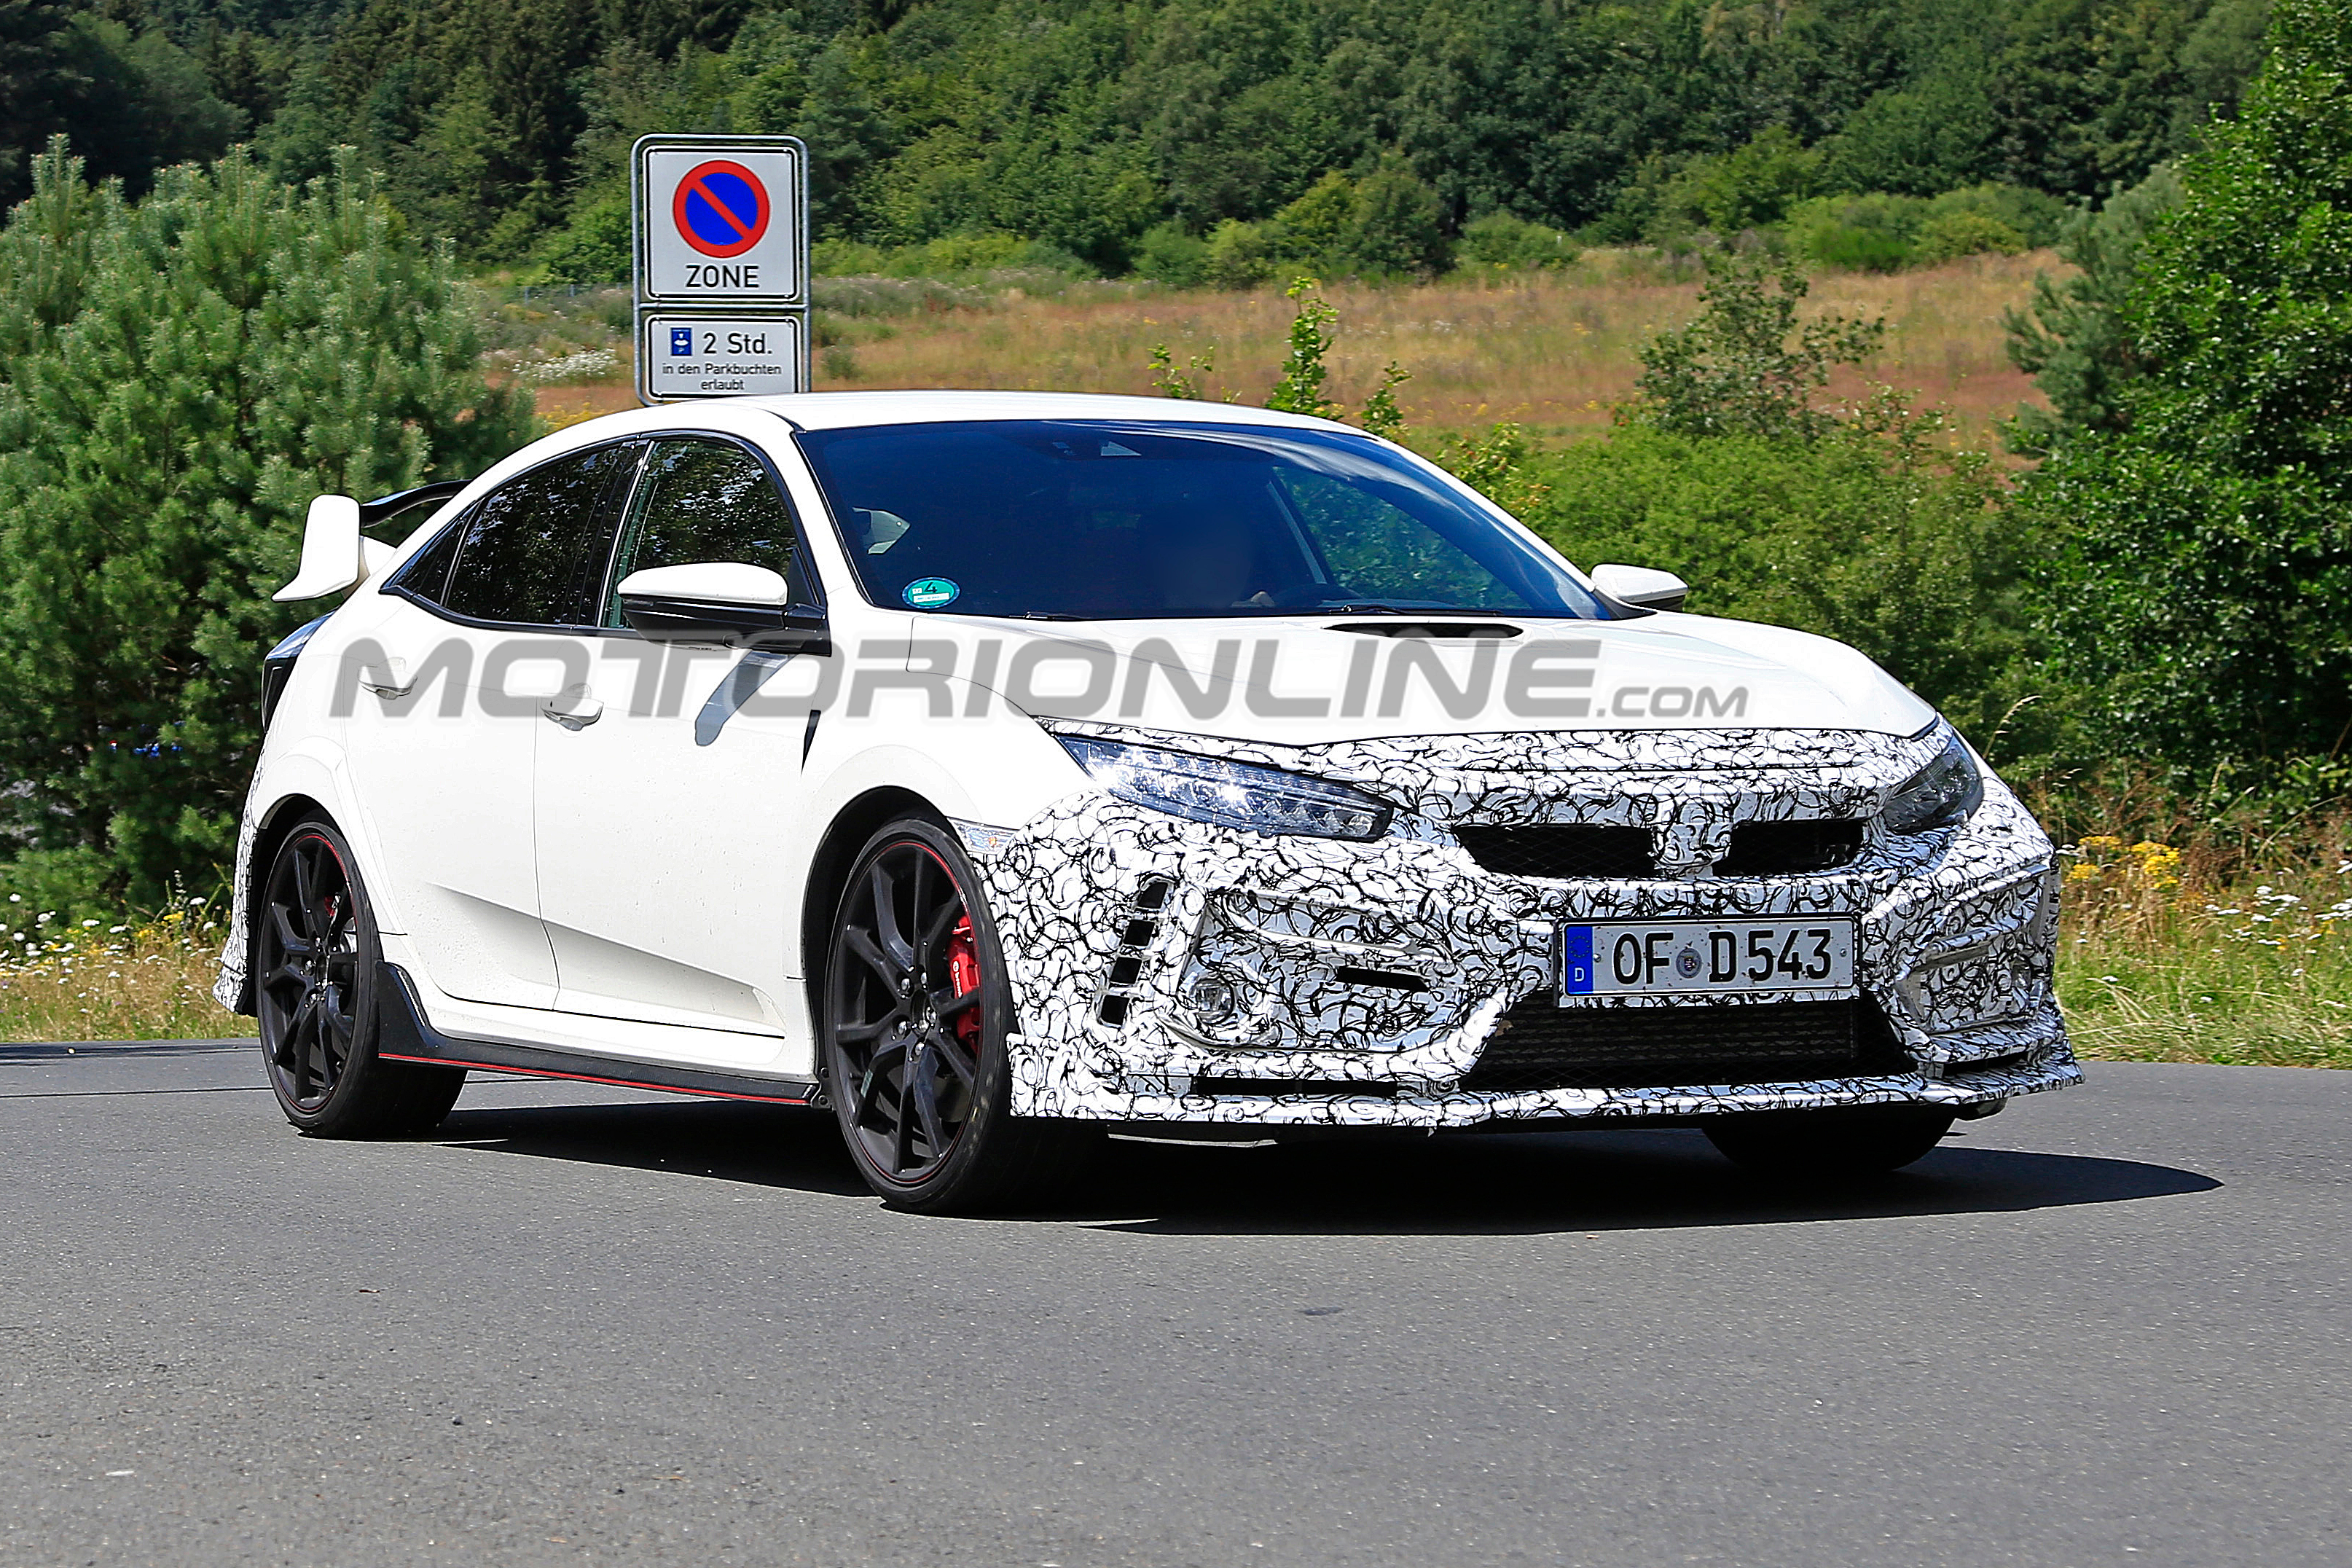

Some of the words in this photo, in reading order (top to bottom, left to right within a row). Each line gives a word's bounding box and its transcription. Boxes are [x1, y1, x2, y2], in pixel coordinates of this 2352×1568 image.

[685, 264, 760, 288] ZONE
[702, 332, 718, 354] 2
[726, 332, 773, 354] Std.
[662, 362, 674, 375] in
[678, 362, 701, 375] den
[705, 363, 782, 375] Parkbuchten
[700, 378, 745, 391] erlaubt
[923, 581, 938, 593] 4
[1613, 932, 1674, 985] OF
[1708, 930, 1737, 983] D
[1748, 928, 1831, 981] 543
[1575, 967, 1584, 982] D
